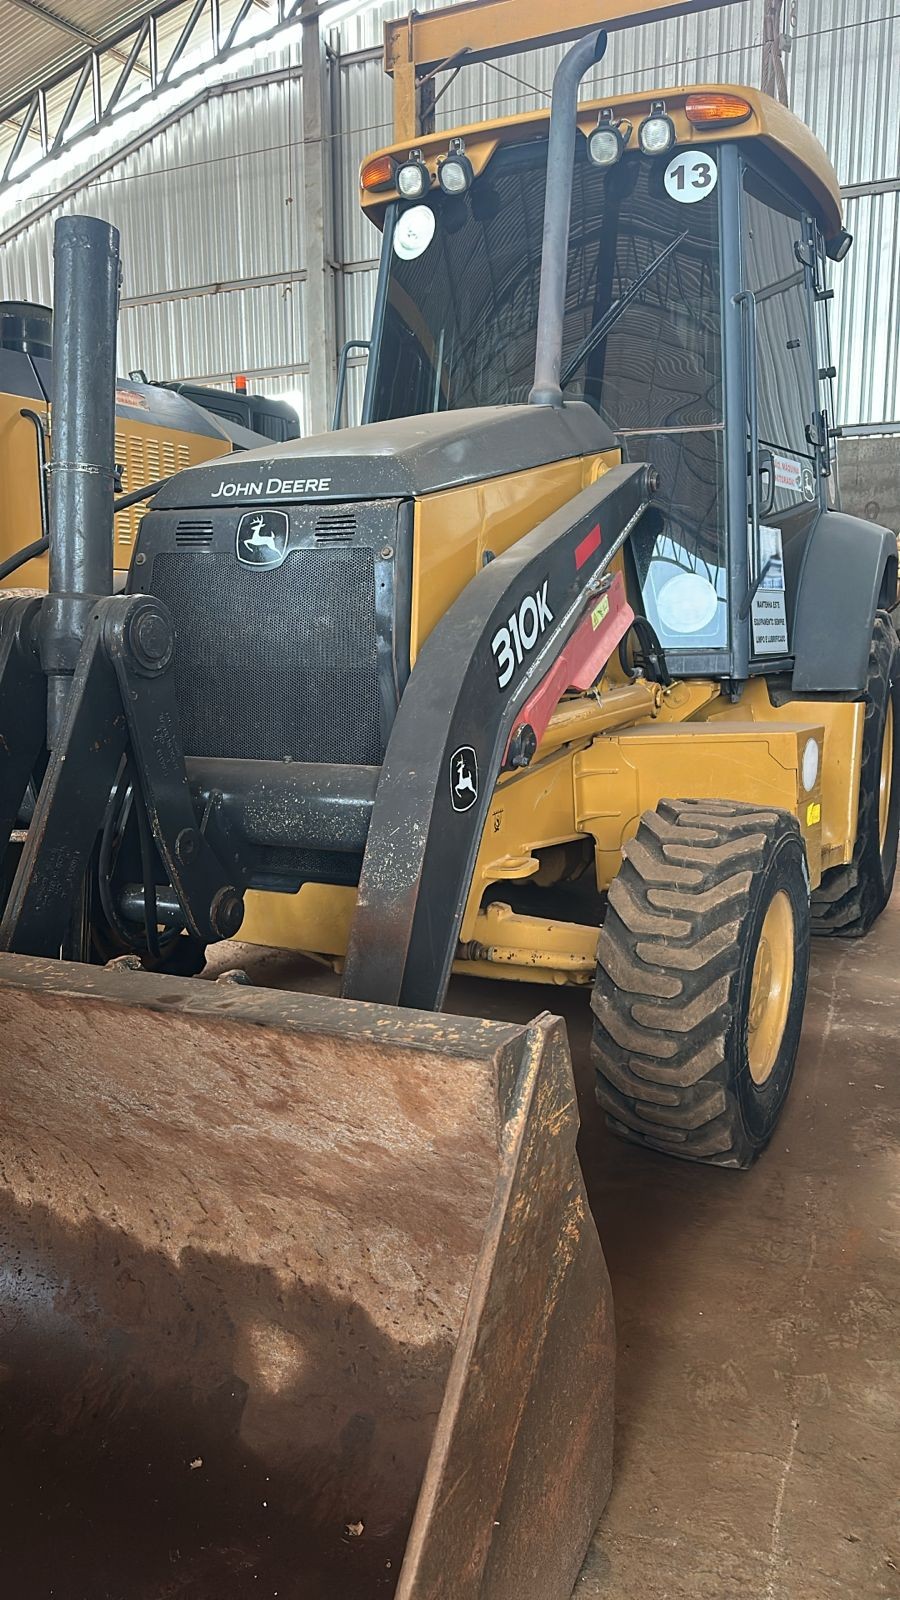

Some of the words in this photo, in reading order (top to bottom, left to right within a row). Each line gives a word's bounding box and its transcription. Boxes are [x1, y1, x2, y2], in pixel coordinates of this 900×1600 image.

[670, 163, 712, 190] 13
[211, 482, 263, 497] JOHN
[265, 478, 331, 494] DEERE
[491, 580, 554, 688] 310K
